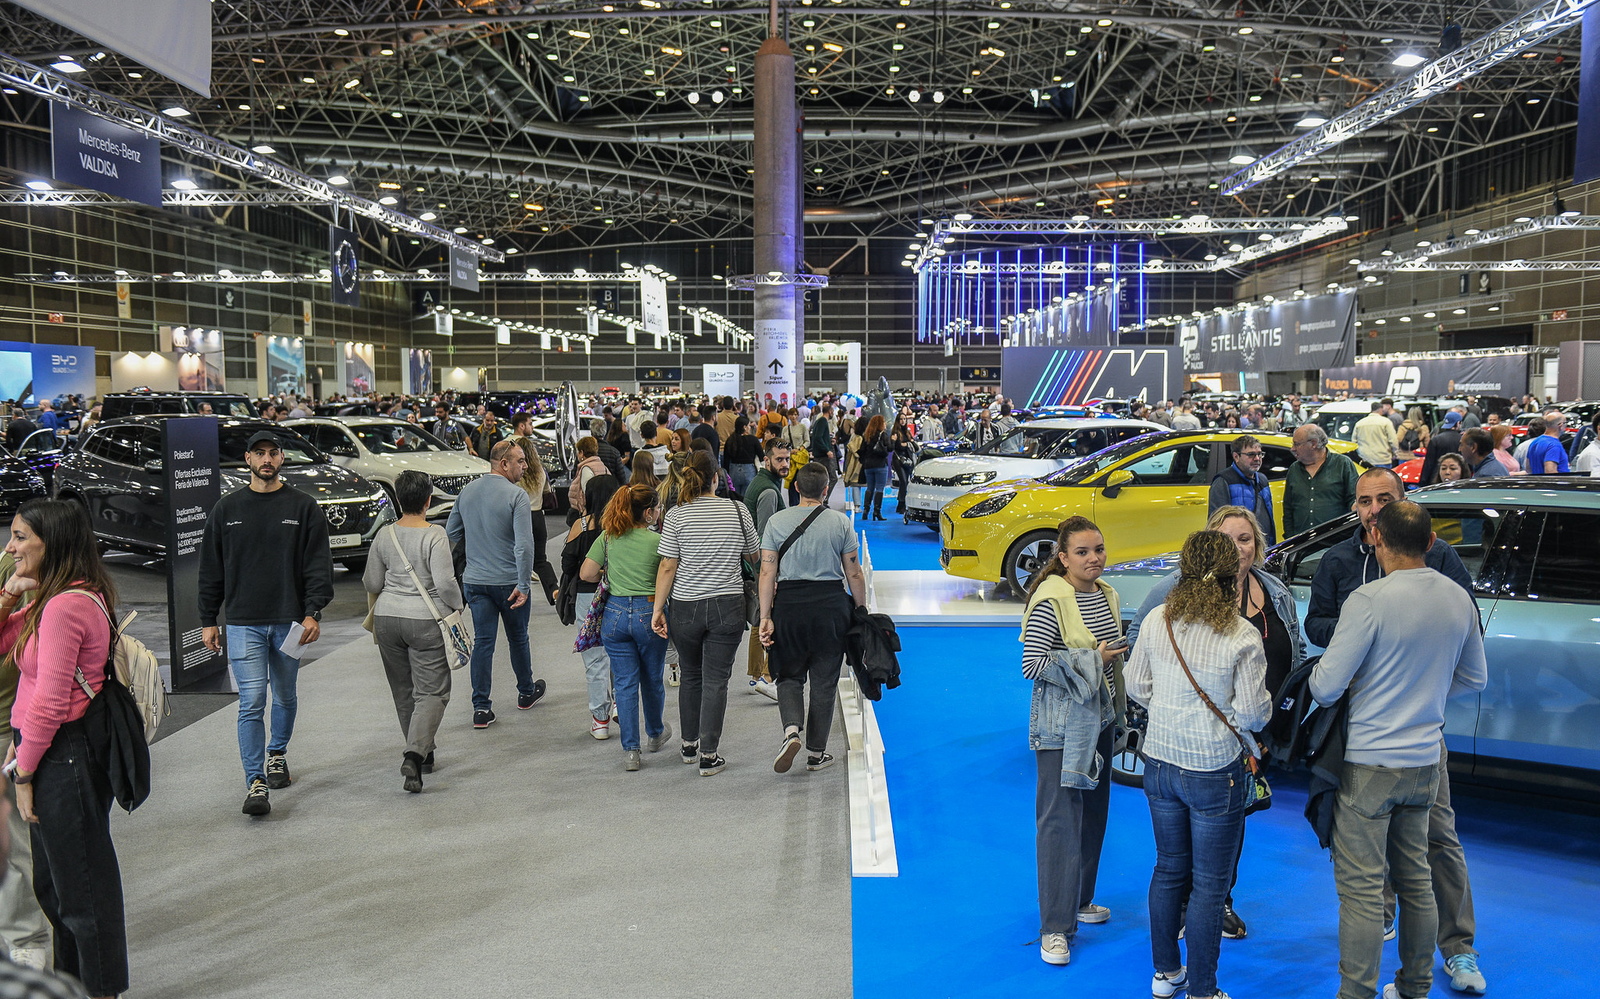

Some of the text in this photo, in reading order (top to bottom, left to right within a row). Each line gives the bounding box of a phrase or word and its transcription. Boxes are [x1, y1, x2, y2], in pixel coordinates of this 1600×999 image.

[79, 127, 141, 163] Mercedes-Benz
[79, 152, 119, 179] VALDISA
[423, 291, 434, 302] A
[604, 290, 613, 301] B
[1211, 327, 1282, 353] STELLANTIS
[51, 354, 78, 366] BYD
[1082, 349, 1168, 404] M
[174, 450, 190, 459] Polestar
[174, 466, 212, 479] Ofertas Exclusivas
[175, 479, 186, 490] Feria
[192, 476, 209, 488] Valencia
[330, 537, 348, 545] EQS
